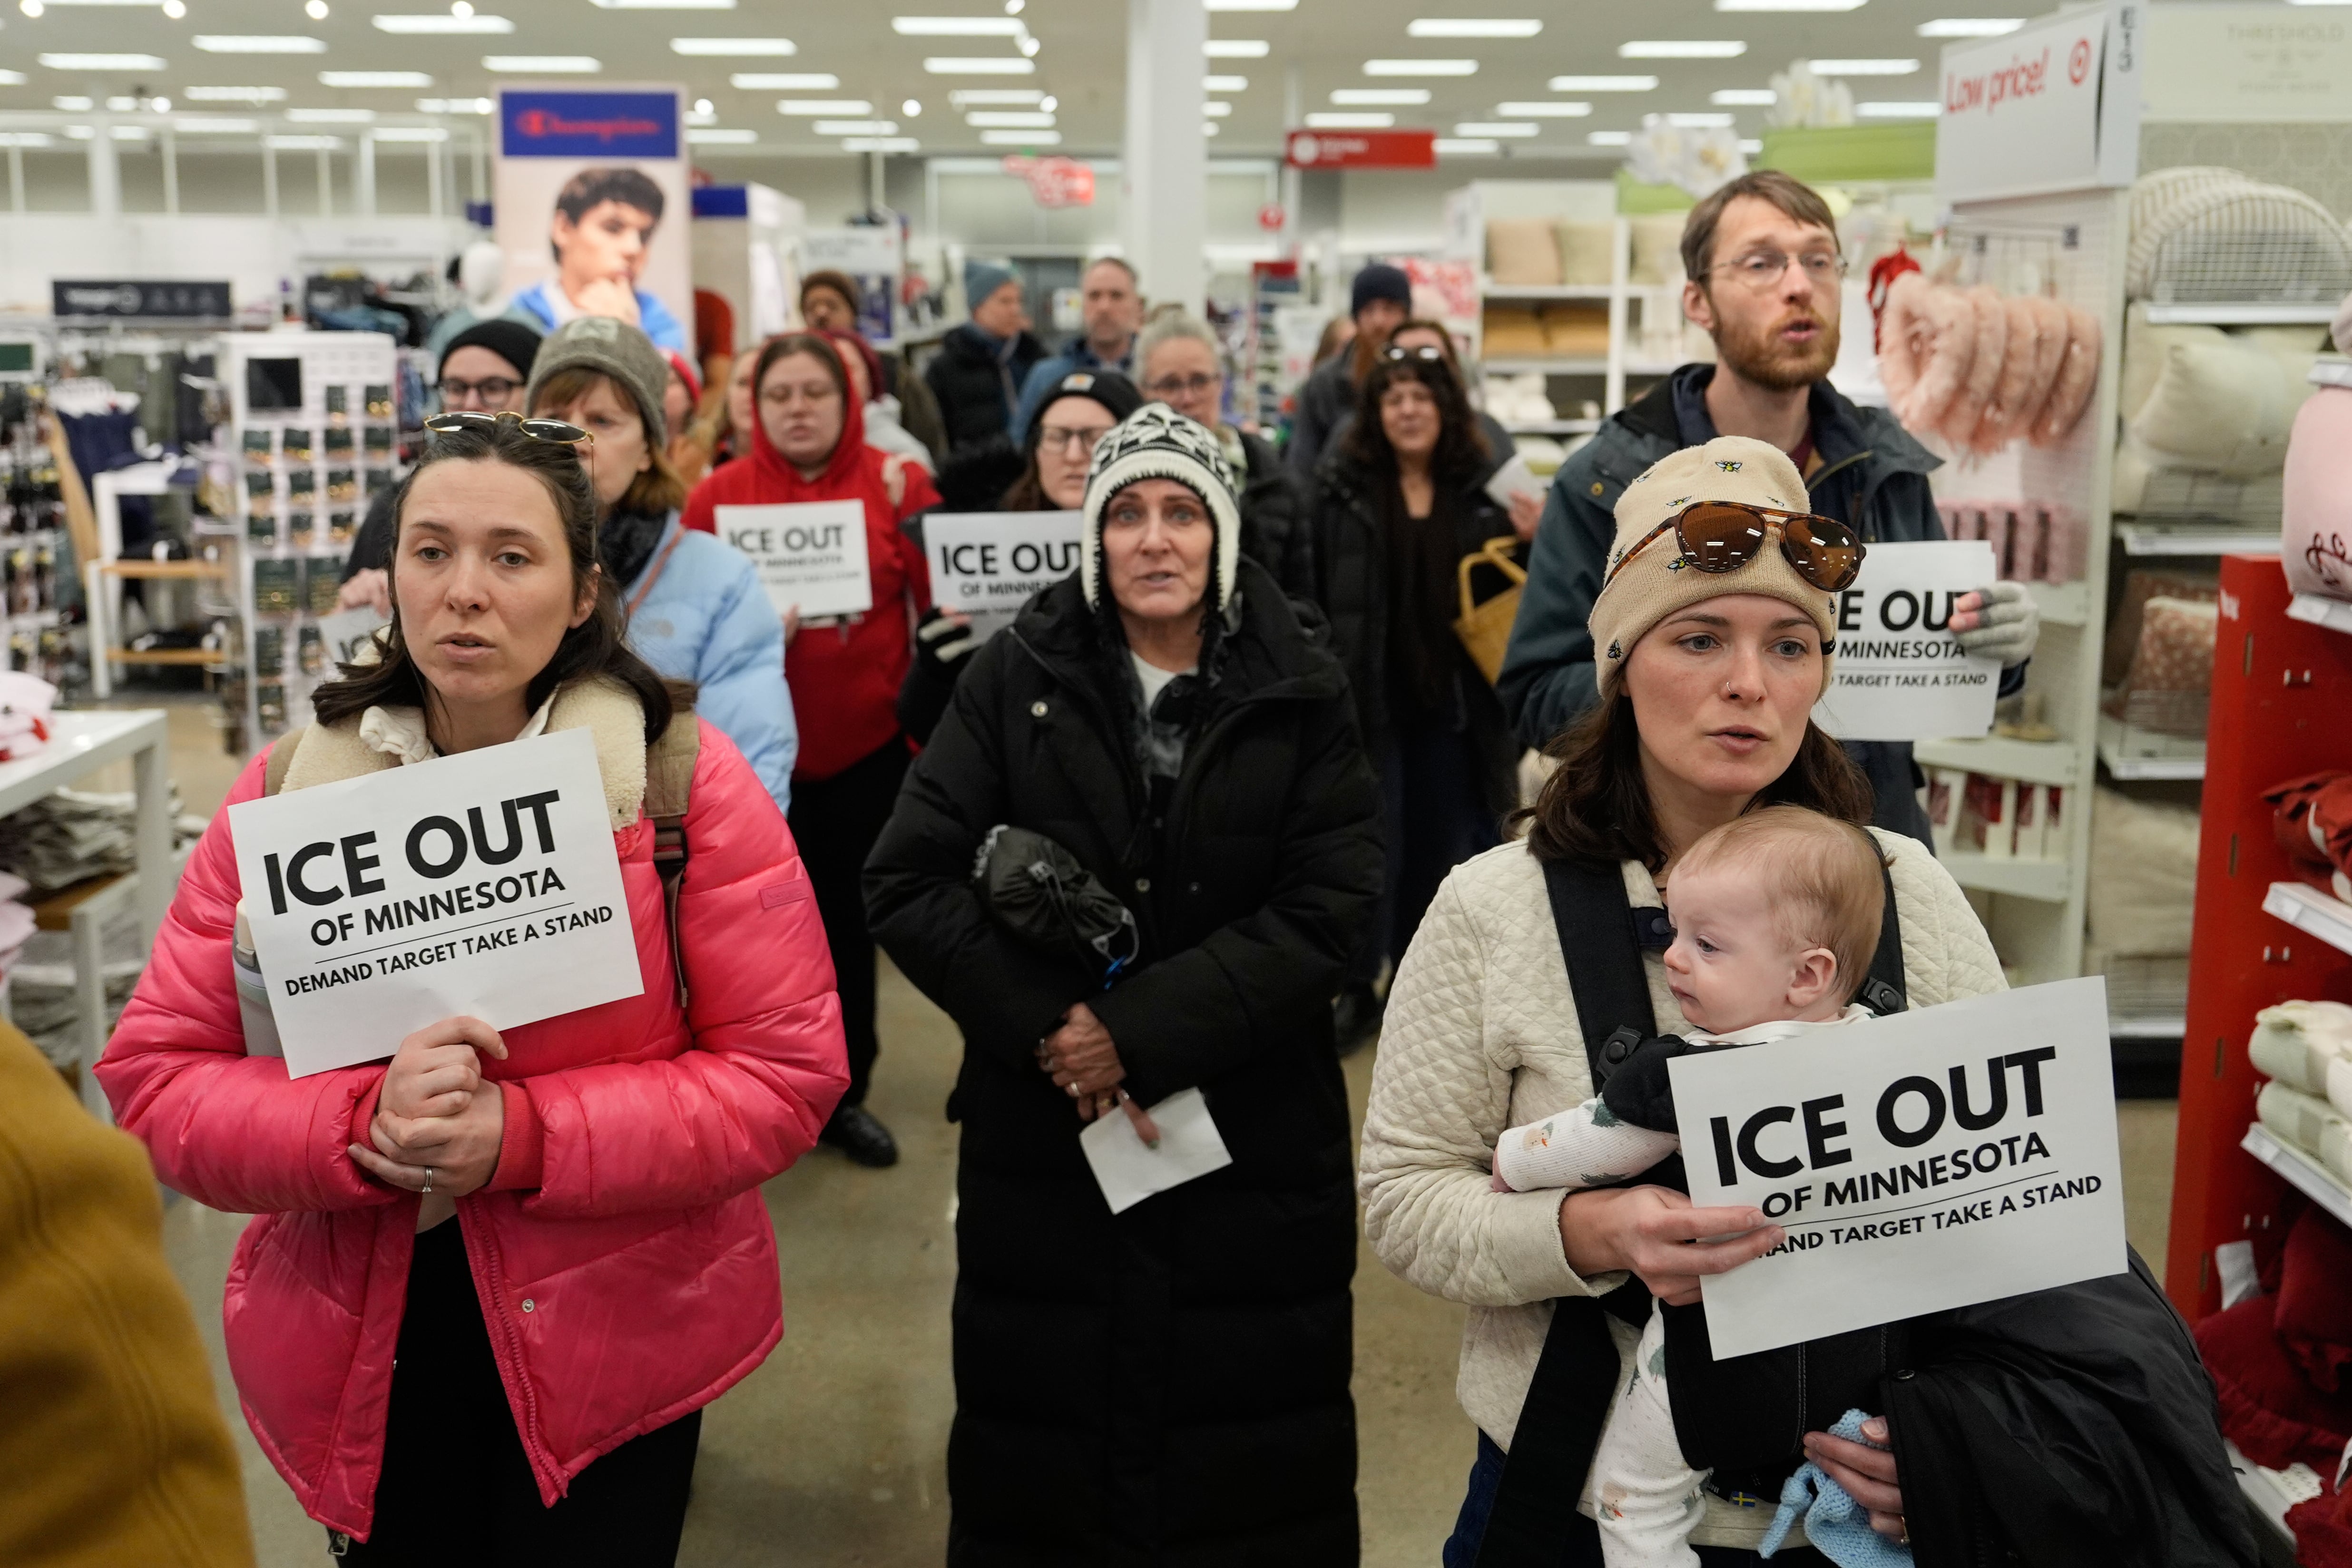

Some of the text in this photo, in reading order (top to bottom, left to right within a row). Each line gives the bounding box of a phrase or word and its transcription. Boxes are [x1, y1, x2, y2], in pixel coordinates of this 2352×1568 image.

[1947, 46, 2050, 115] Low price!
[729, 524, 845, 553] ICE OUT
[942, 544, 998, 575] ICE
[960, 582, 980, 596] OF
[1838, 674, 1891, 686] TARGET
[1896, 674, 1927, 686] TAKE
[1931, 674, 1940, 686] A
[1944, 673, 1987, 686] STAND
[1839, 641, 1966, 658] MINNESOTA
[263, 789, 560, 915] ICE OUT
[311, 867, 566, 946] OF MINNESOTA
[285, 906, 613, 996] DEMAND TARGET TAKE A STAND
[1710, 1046, 2056, 1187] ICE OUT
[1763, 1132, 2050, 1218] OF MINNESOTA
[1830, 1216, 1926, 1245] TARGET
[1931, 1200, 1993, 1231] TAKE
[1999, 1196, 2017, 1217] A
[2023, 1175, 2102, 1209] STAND
